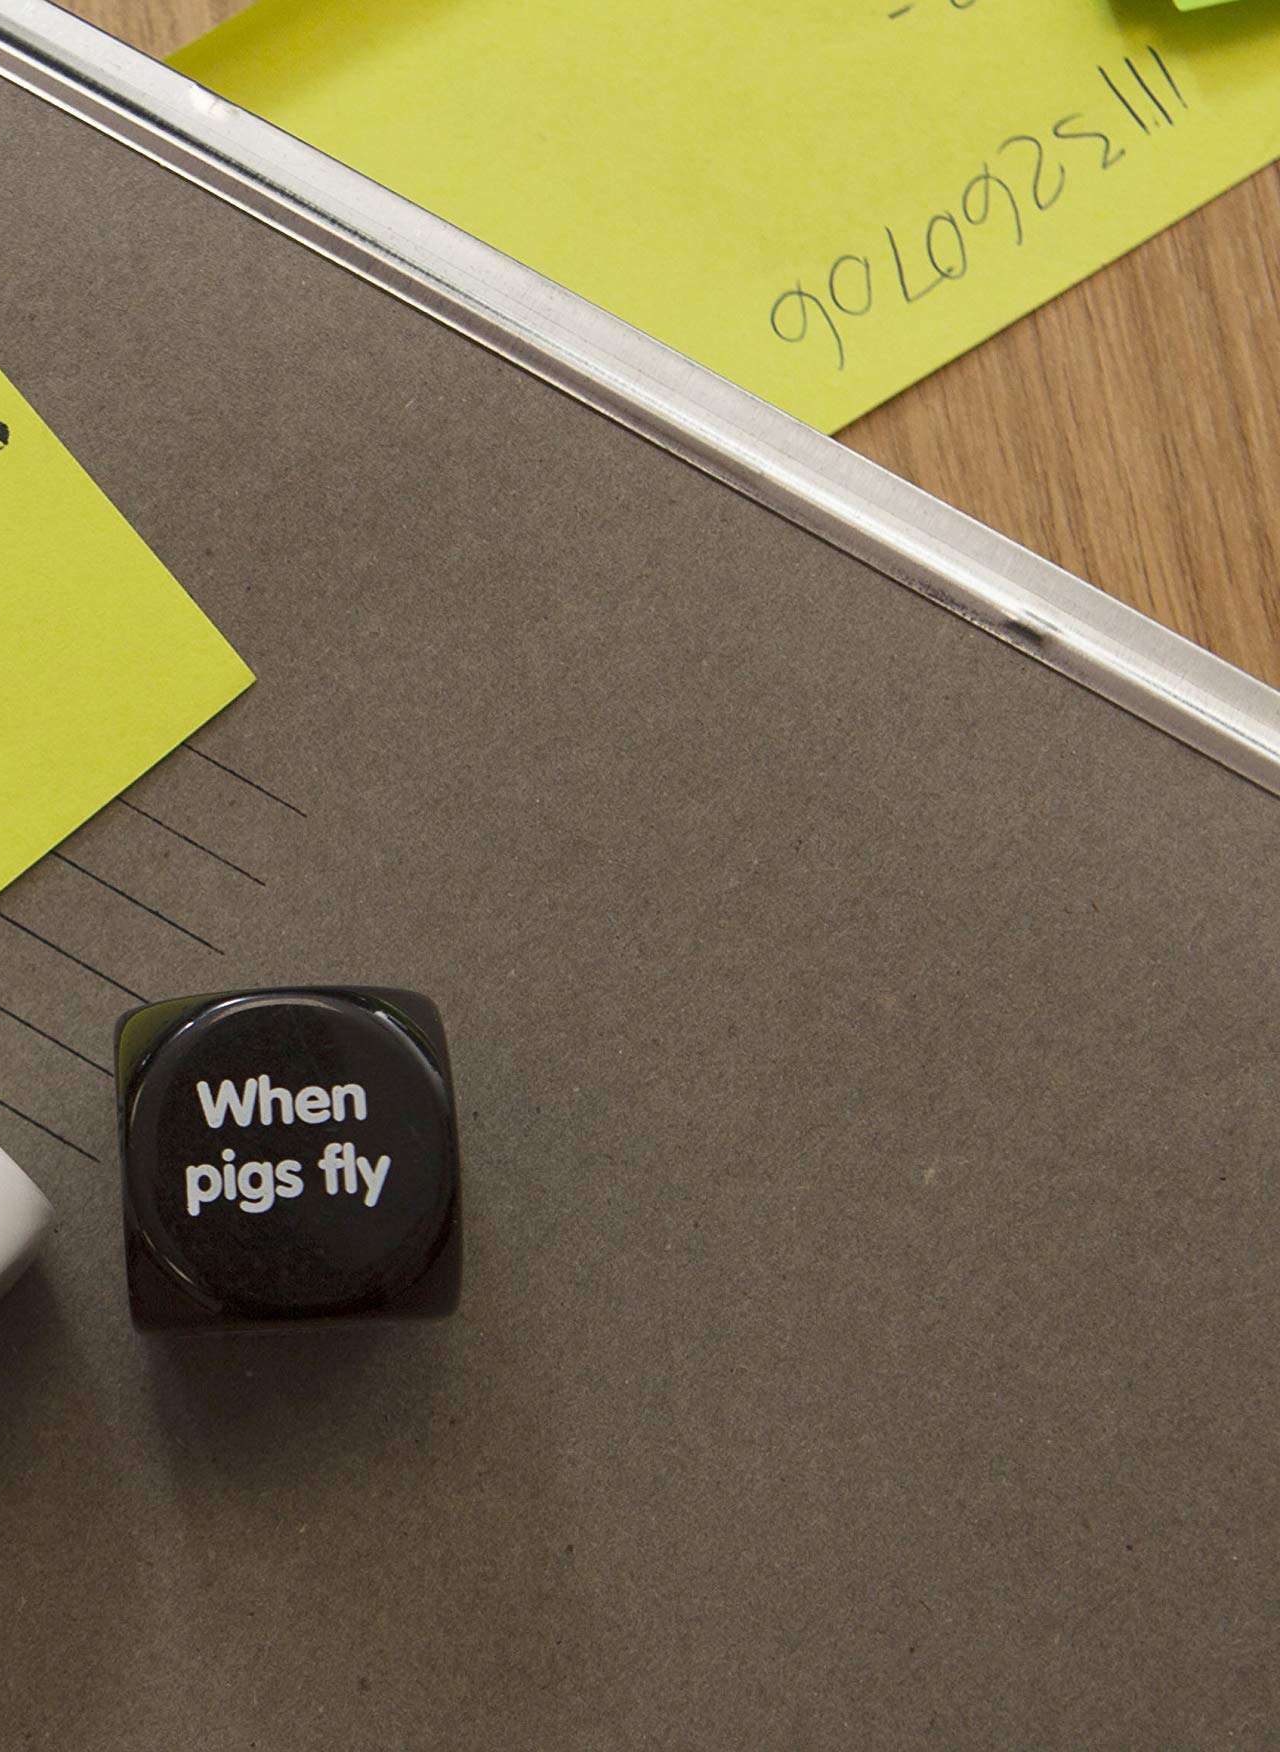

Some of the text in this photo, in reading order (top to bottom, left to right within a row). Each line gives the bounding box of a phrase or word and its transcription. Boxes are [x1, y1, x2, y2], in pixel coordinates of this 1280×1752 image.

[196, 1074, 367, 1129] When
[185, 1142, 391, 1217] pigs fly
